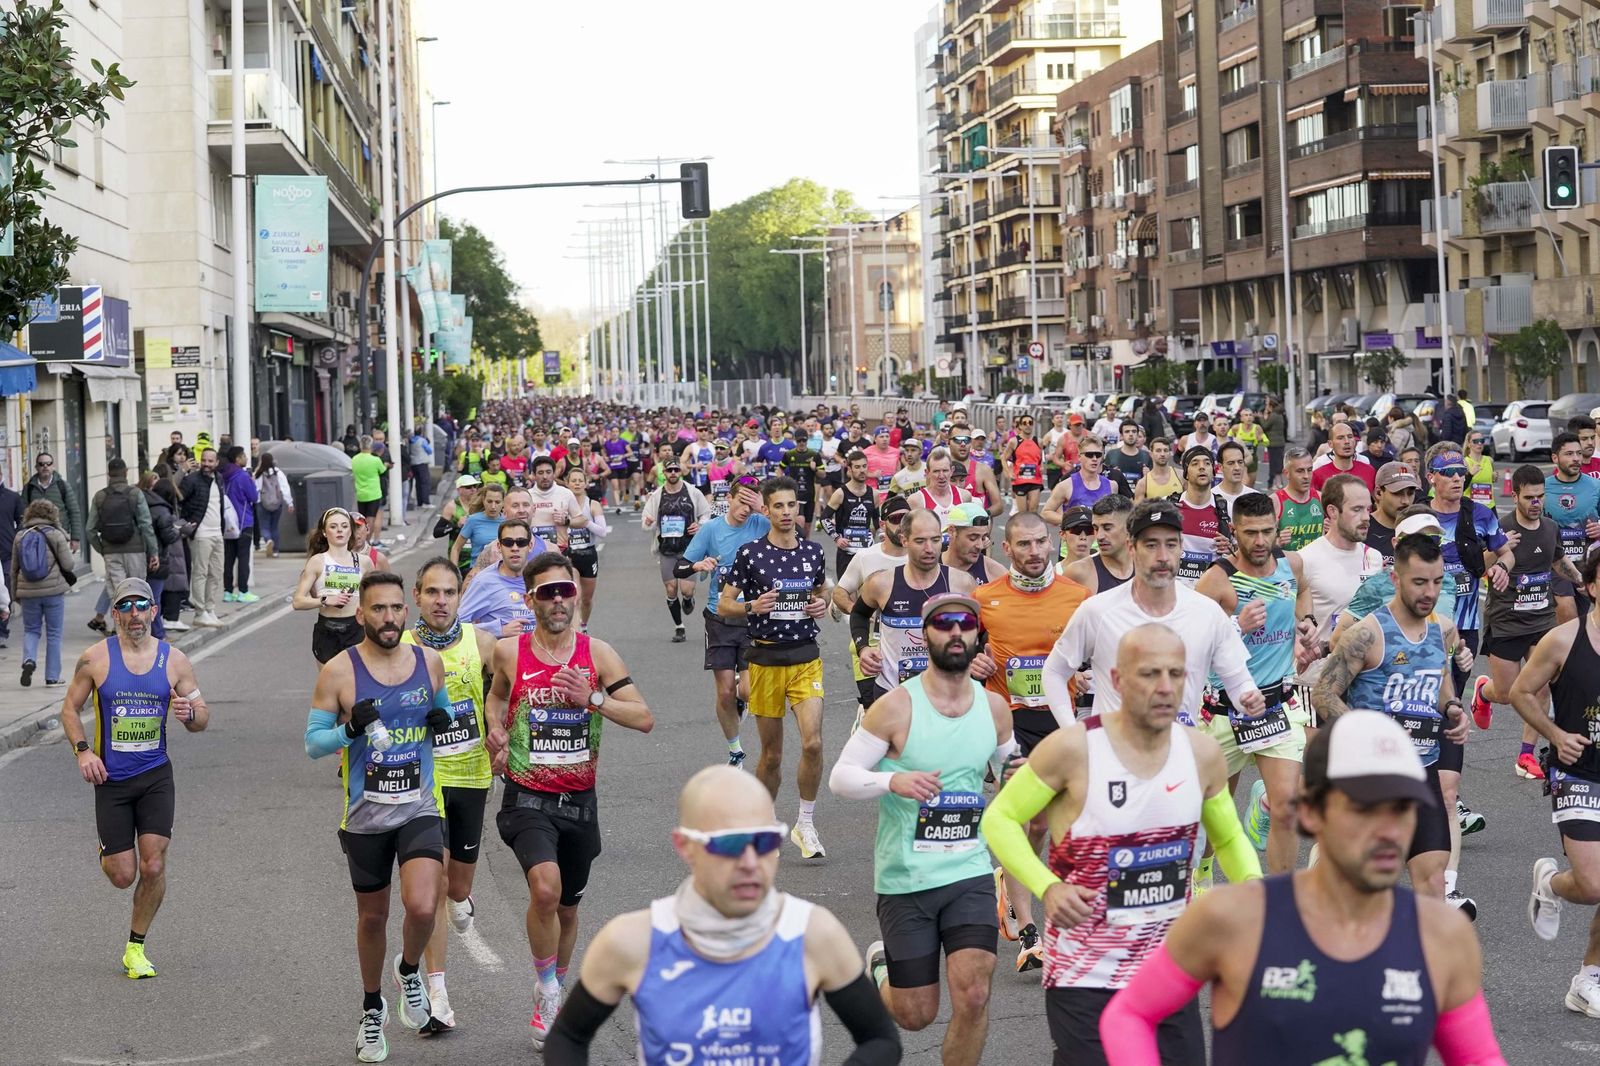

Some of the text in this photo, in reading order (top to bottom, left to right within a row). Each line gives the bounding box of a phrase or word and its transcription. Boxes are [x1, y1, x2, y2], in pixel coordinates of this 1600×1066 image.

[552, 712, 585, 720] ZURICH
[1404, 720, 1421, 729] 3923
[117, 730, 156, 740] EDWARD
[367, 726, 427, 746] SSAM
[435, 728, 470, 745] PITISO
[552, 728, 571, 736] 3936
[1238, 720, 1286, 743] LUISINHO
[533, 738, 586, 752] MANOLEN
[387, 752, 416, 762] ZURICH
[378, 779, 410, 792] MELLI
[1570, 784, 1589, 792] 4533
[944, 796, 978, 804] ZURICH
[942, 814, 960, 824] 4032
[924, 824, 970, 840] CABERO
[1138, 845, 1182, 862] ZURICH
[1138, 871, 1162, 884] 4739
[1124, 884, 1174, 906] MARIO
